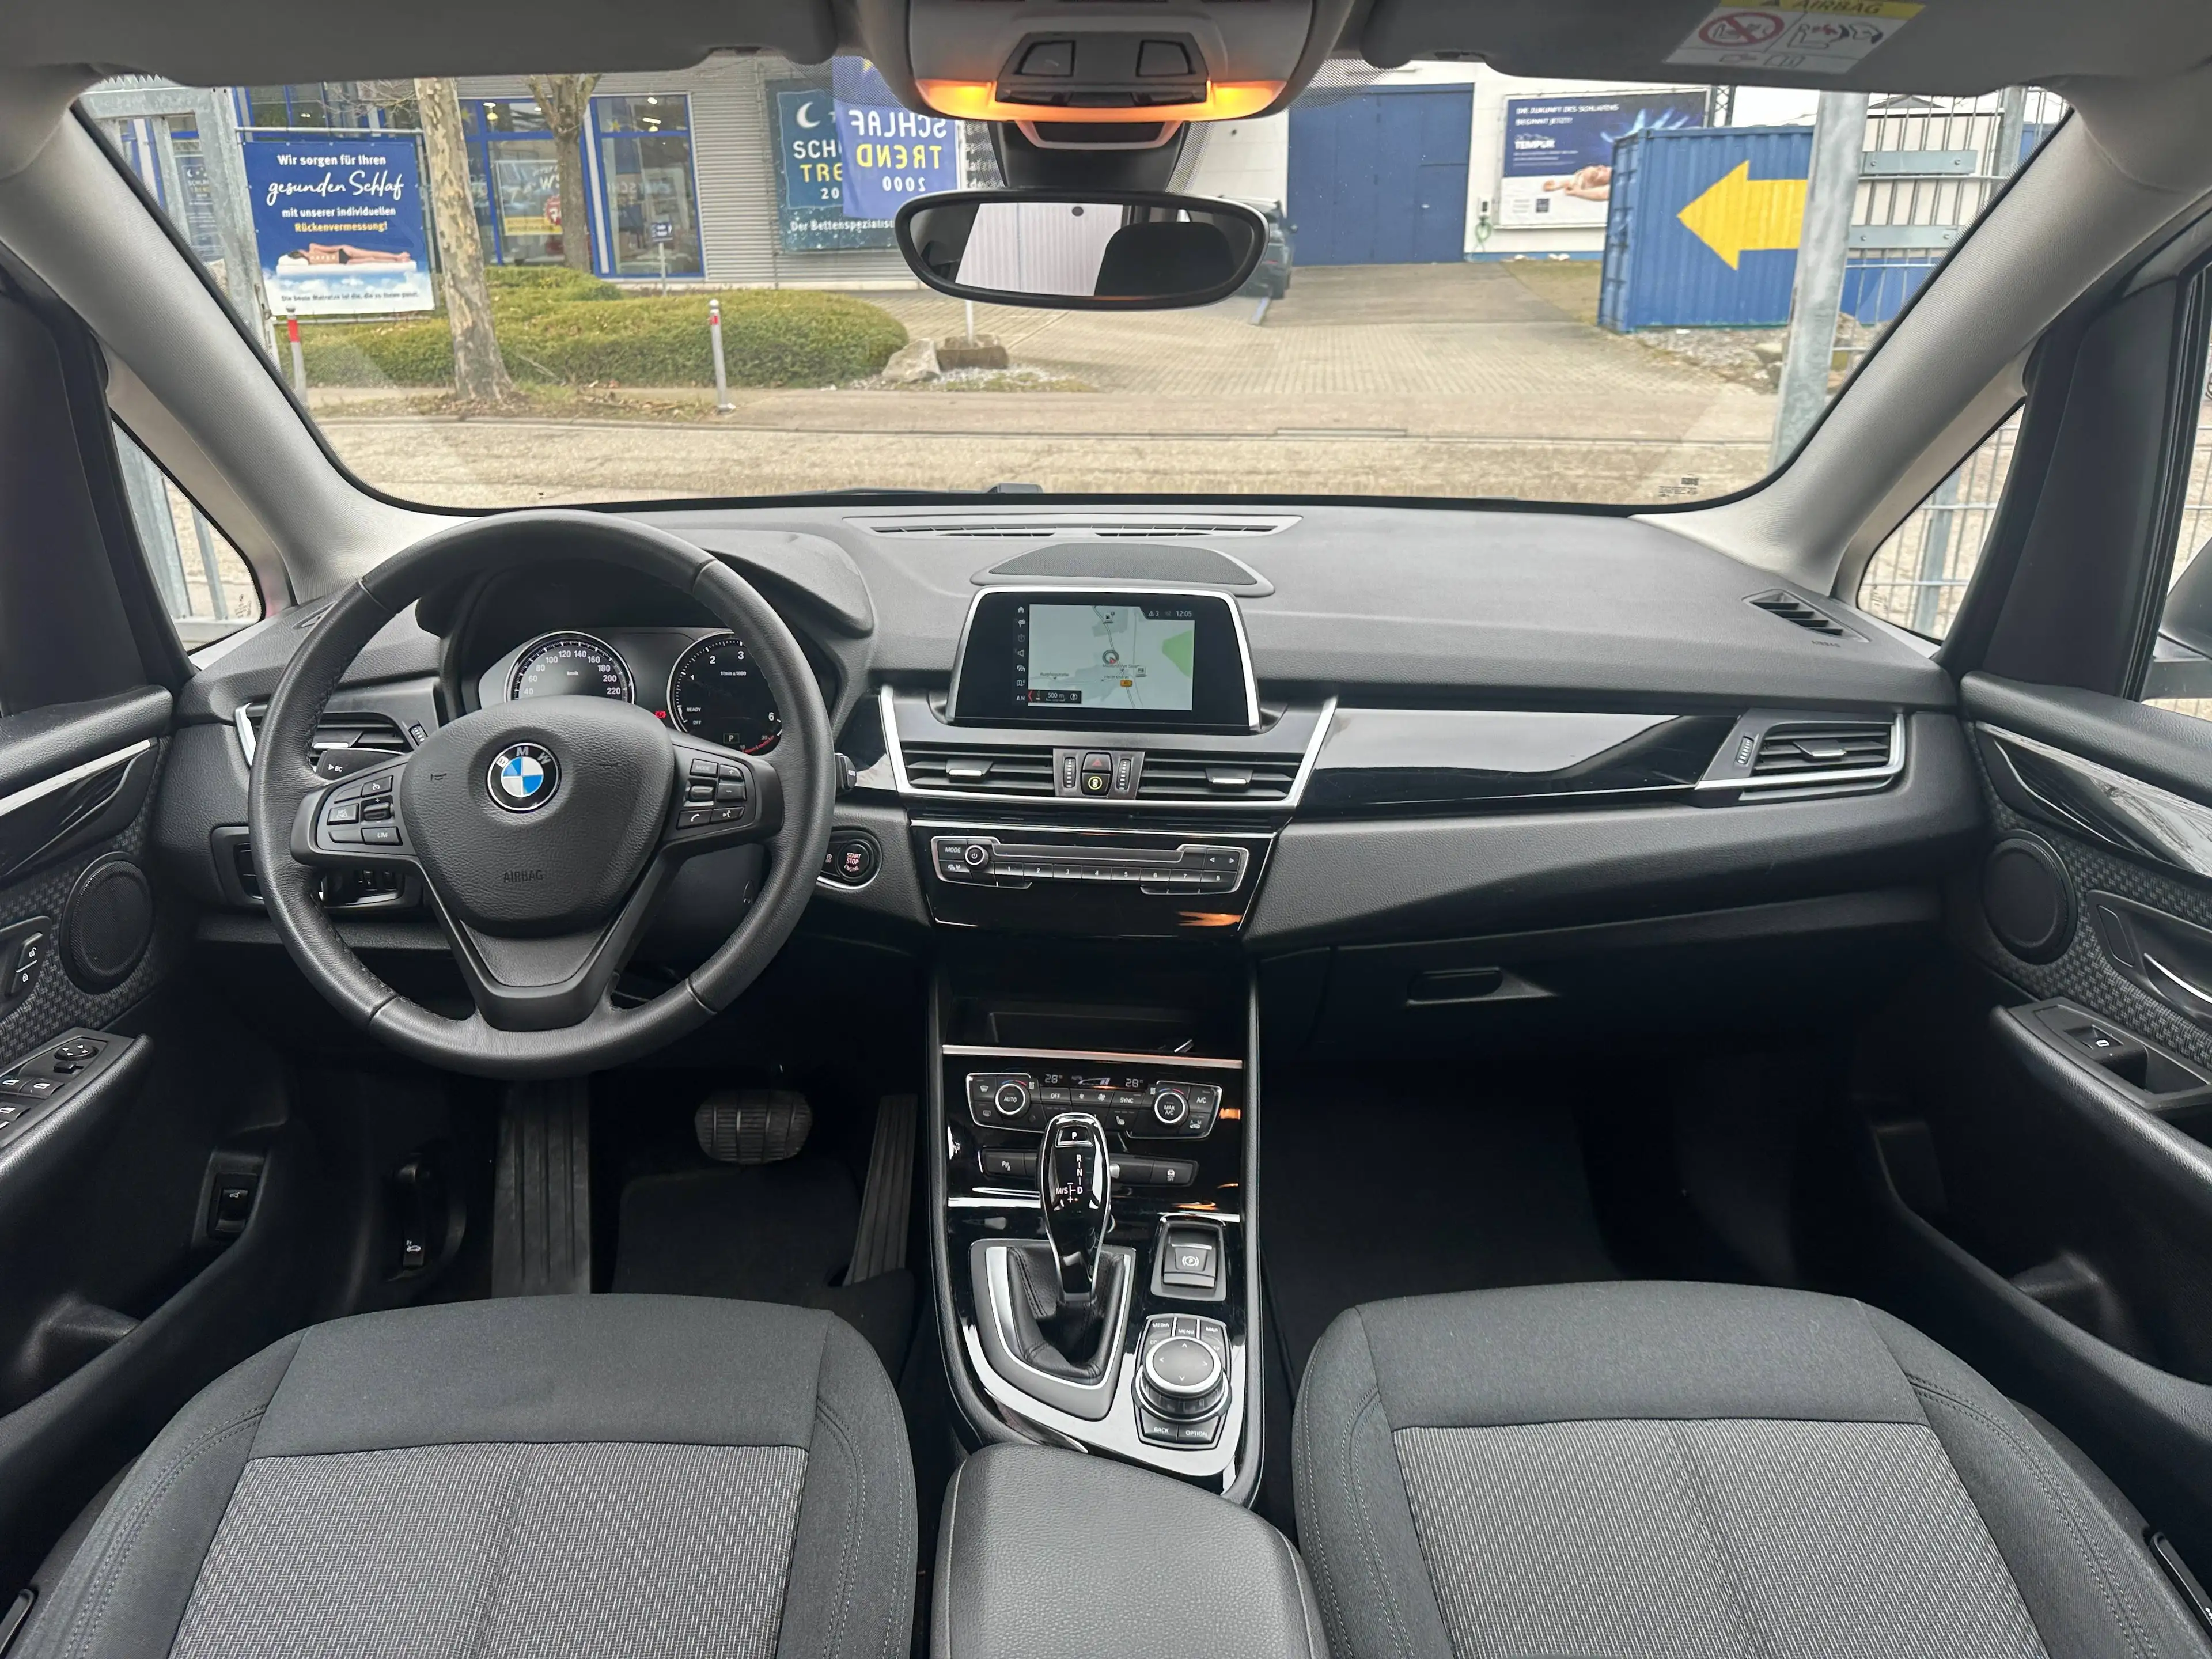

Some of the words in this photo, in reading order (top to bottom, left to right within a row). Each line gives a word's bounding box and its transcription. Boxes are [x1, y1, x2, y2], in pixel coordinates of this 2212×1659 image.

[1791, 0, 1882, 14] AIRBAG
[793, 139, 842, 159] SCH
[1514, 140, 1555, 149] TEMPUR
[277, 154, 296, 165] Wir
[300, 155, 338, 167] sorgen
[340, 154, 355, 165] für
[358, 154, 386, 165] Ihren
[800, 164, 843, 182] TRE
[266, 172, 346, 206] gesunden
[349, 170, 404, 200] Schlaf
[820, 187, 840, 199] 20
[282, 208, 298, 218] mit
[300, 208, 335, 217] unserer
[337, 206, 396, 217] individuellen
[294, 221, 387, 232] Rückenvermessung!
[790, 221, 808, 232] Der
[710, 656, 715, 664] 2
[738, 651, 744, 660] 3
[768, 713, 774, 721] 6
[496, 747, 551, 768] BMW
[503, 870, 543, 883] AIRBAG
